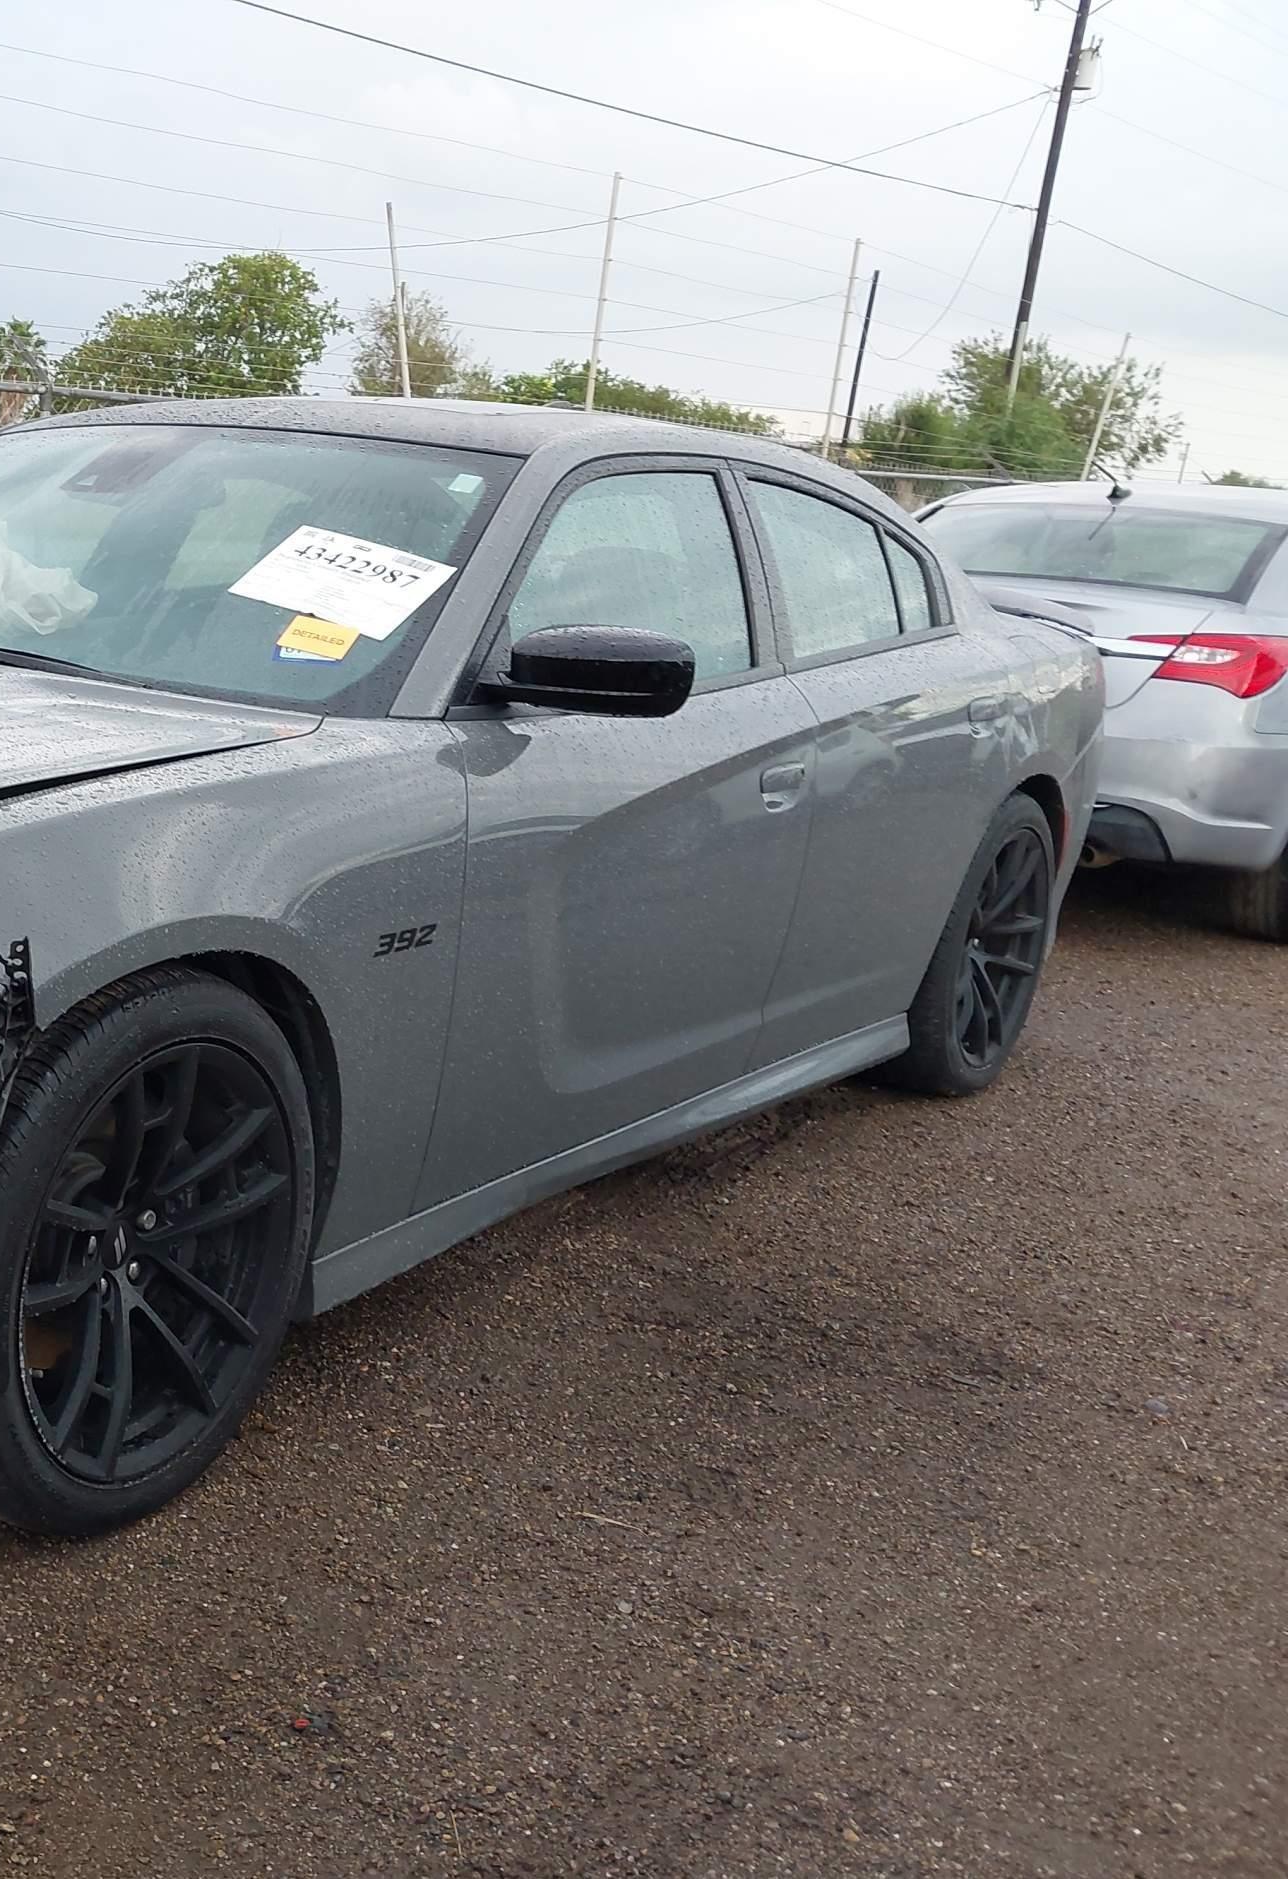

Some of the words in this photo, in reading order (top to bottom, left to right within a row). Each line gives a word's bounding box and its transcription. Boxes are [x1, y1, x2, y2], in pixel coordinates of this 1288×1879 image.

[294, 545, 421, 588] 43422987
[292, 628, 345, 646] DETAILED
[372, 923, 437, 958] 392
